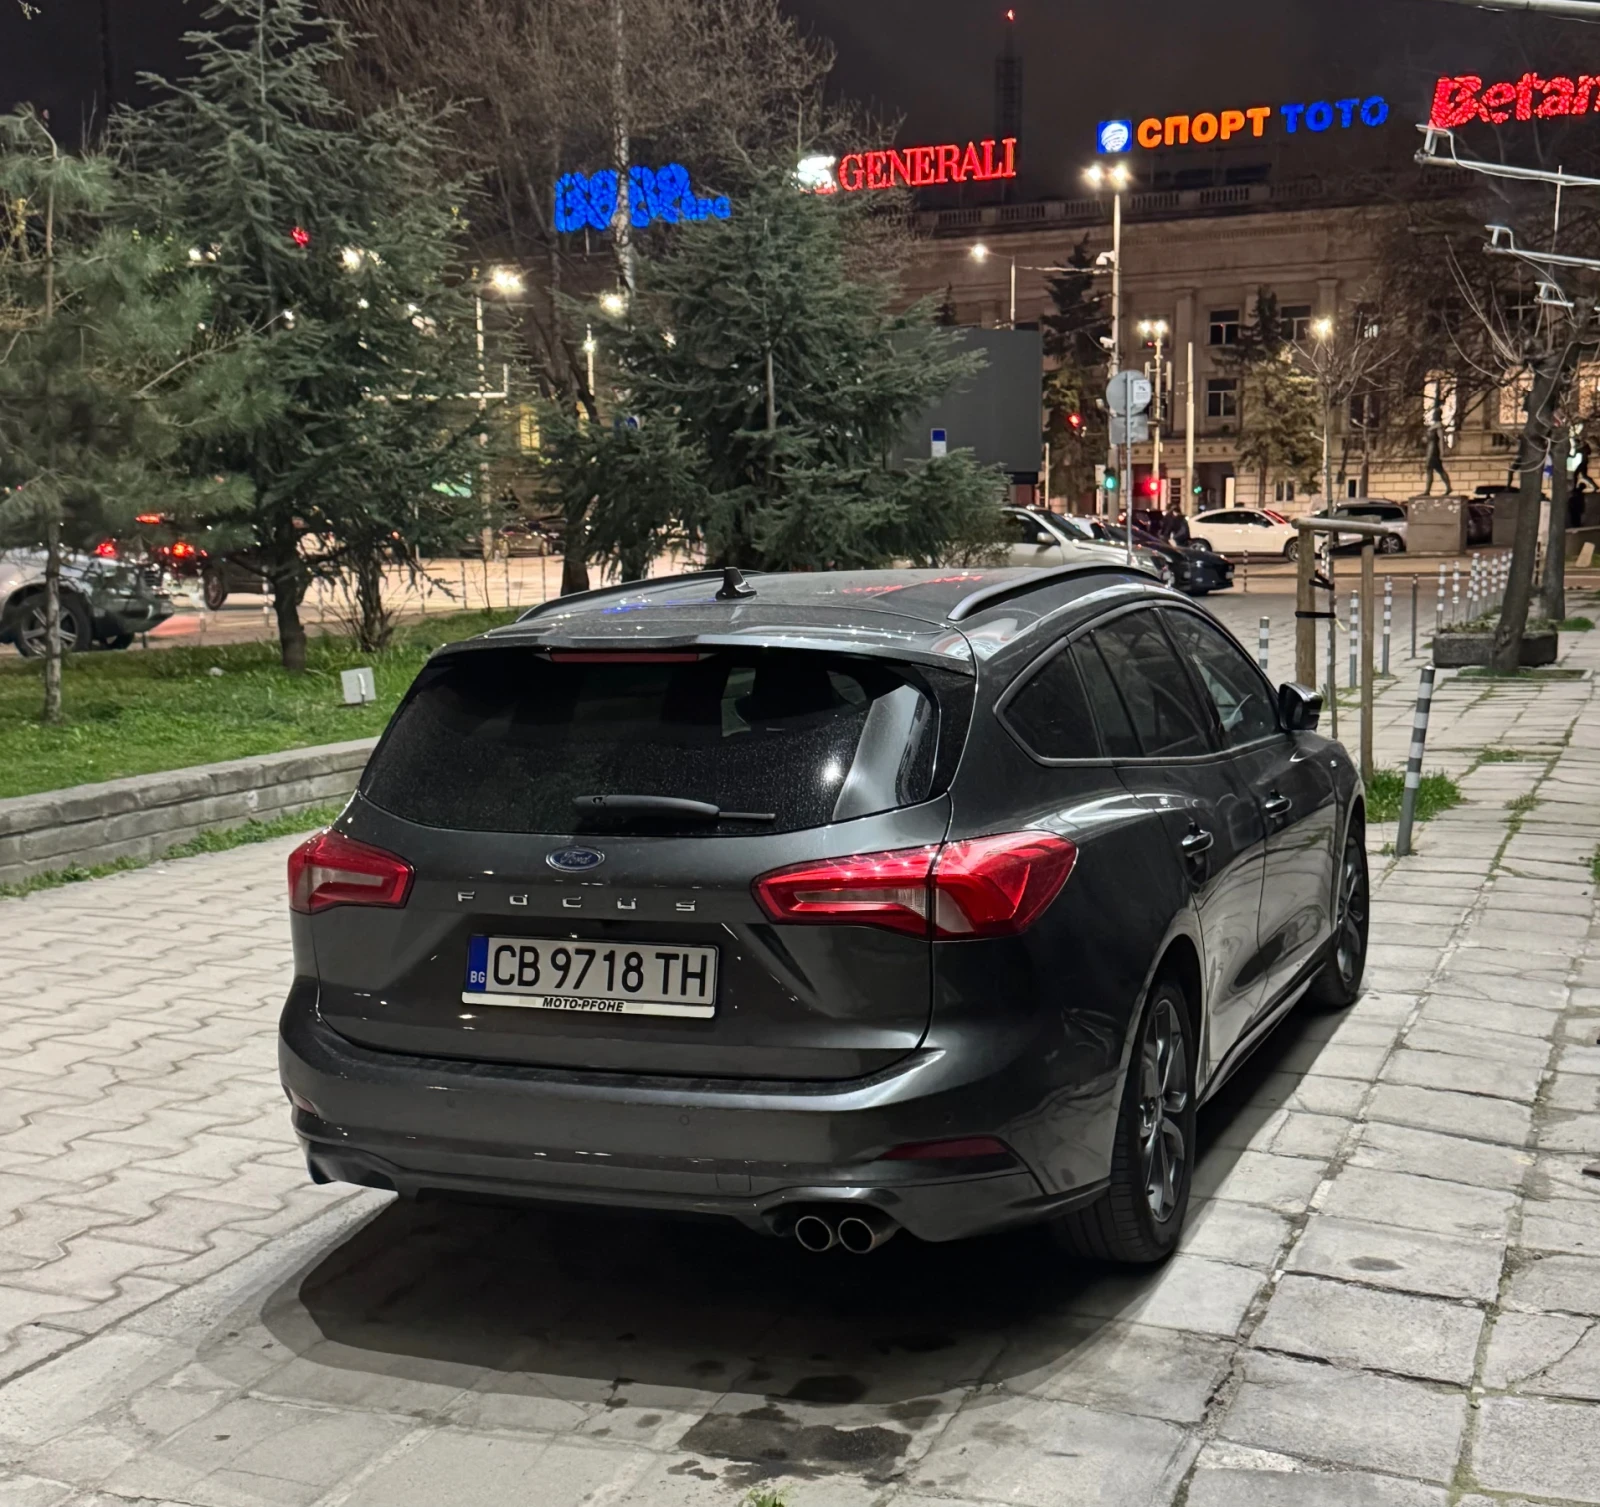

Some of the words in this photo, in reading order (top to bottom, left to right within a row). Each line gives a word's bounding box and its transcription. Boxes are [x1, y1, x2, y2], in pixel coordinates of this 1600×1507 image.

[1137, 106, 1271, 149] СПОРТ
[1280, 95, 1389, 133] ТОТО
[838, 138, 1017, 191] GENERALI
[559, 851, 593, 865] Ford
[457, 891, 696, 912] FOCUS
[470, 971, 486, 984] BG
[493, 945, 541, 987] CB
[550, 947, 644, 993] 9718
[655, 952, 708, 997] TH
[542, 997, 624, 1012] MOTO-PFOHE
